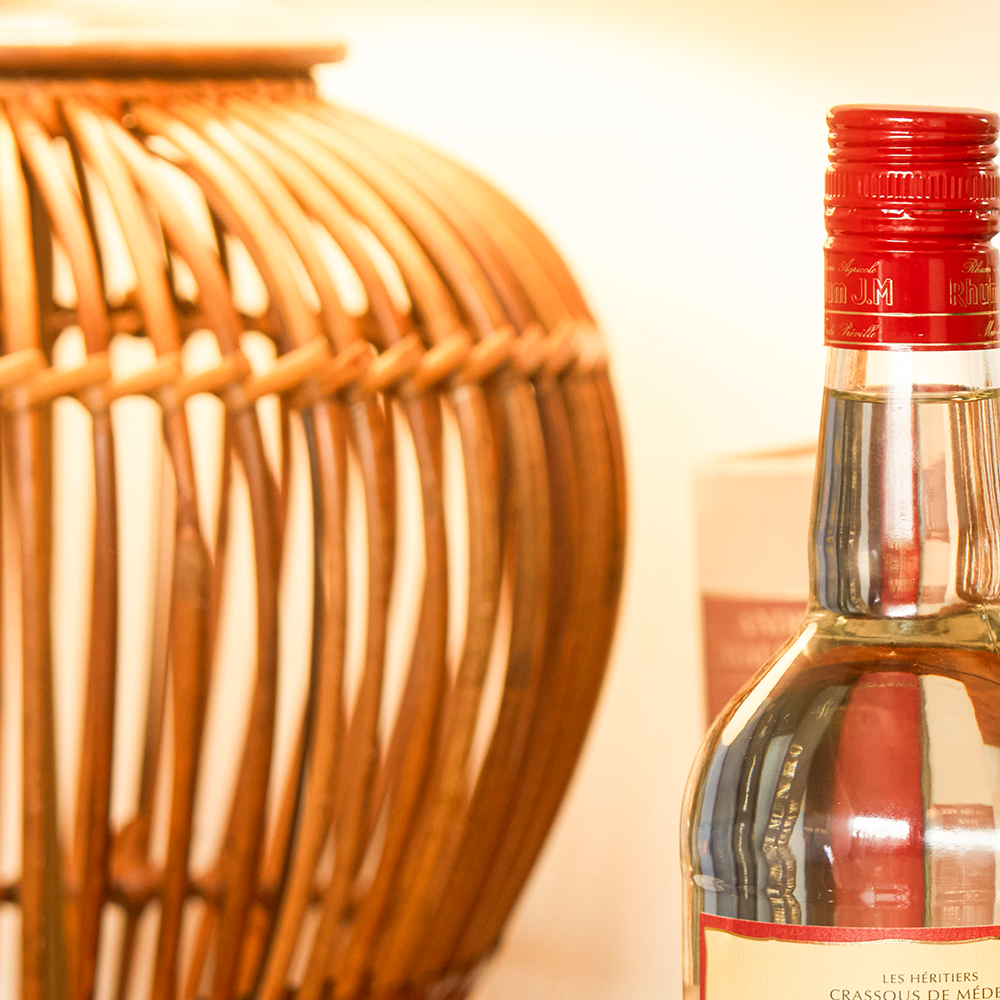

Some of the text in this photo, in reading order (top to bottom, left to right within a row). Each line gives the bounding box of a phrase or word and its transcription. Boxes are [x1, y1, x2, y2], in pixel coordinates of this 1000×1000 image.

[850, 277, 893, 306] J.M
[882, 970, 979, 984] LES HÉRITIERS
